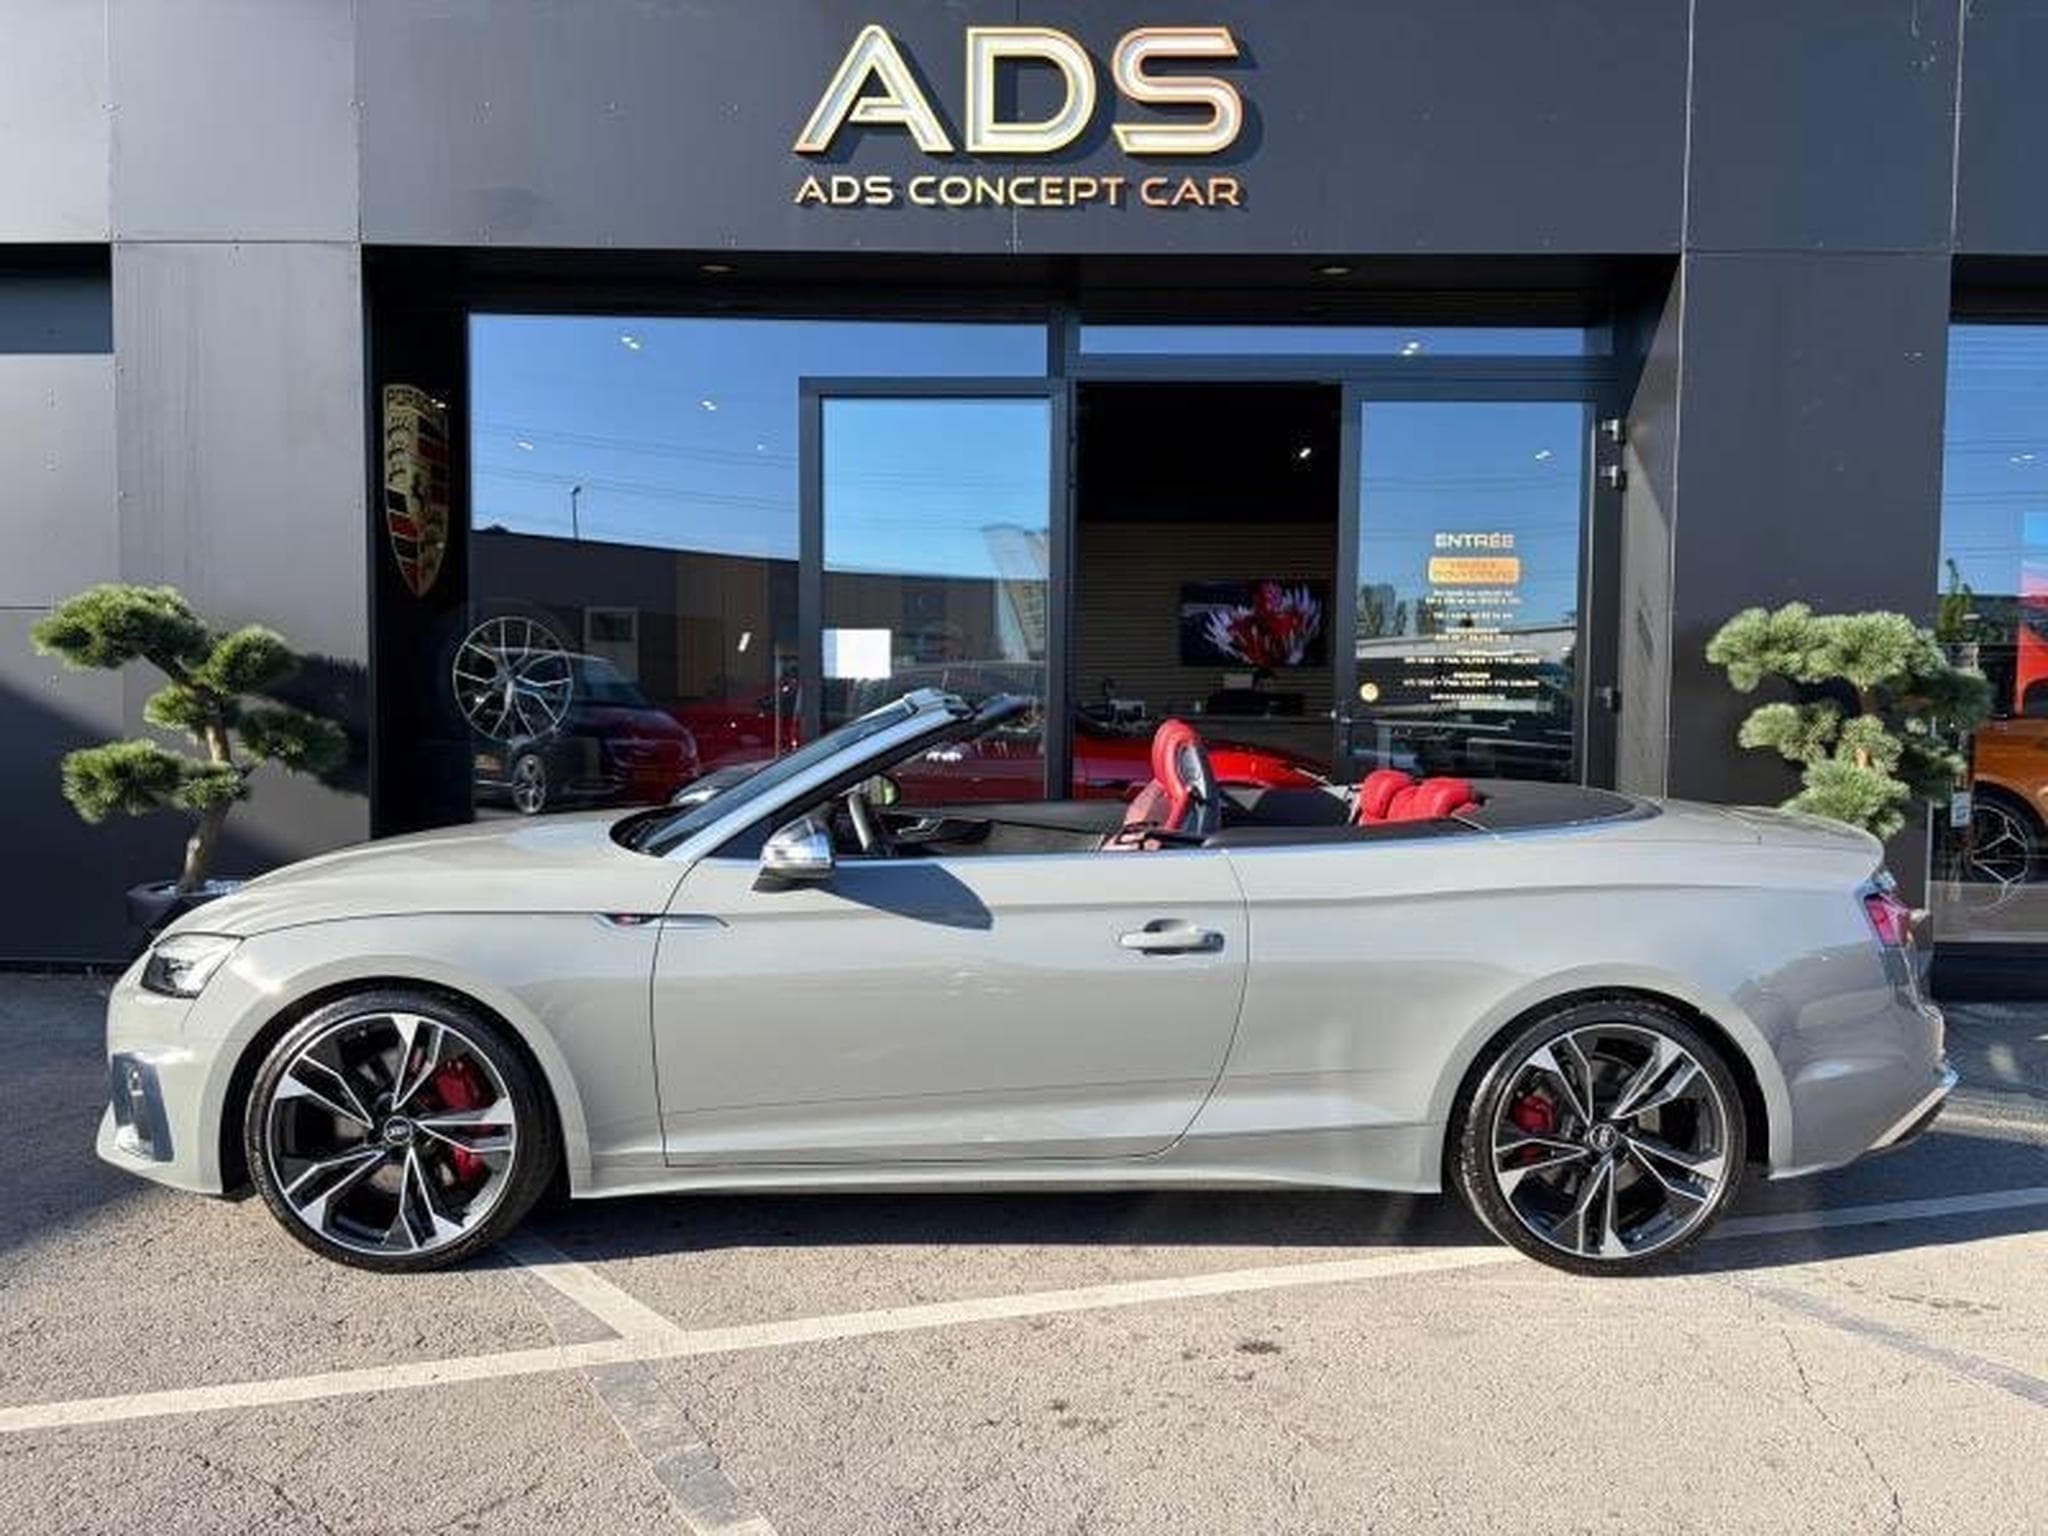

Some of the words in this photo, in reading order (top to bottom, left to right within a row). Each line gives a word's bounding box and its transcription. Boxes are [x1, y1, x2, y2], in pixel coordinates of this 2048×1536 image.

[793, 24, 1243, 154] ADS
[794, 175, 894, 206] ADS
[908, 175, 1124, 206] CONCEPT
[1139, 177, 1240, 206] CAR
[1434, 532, 1516, 549] ENTRÉE
